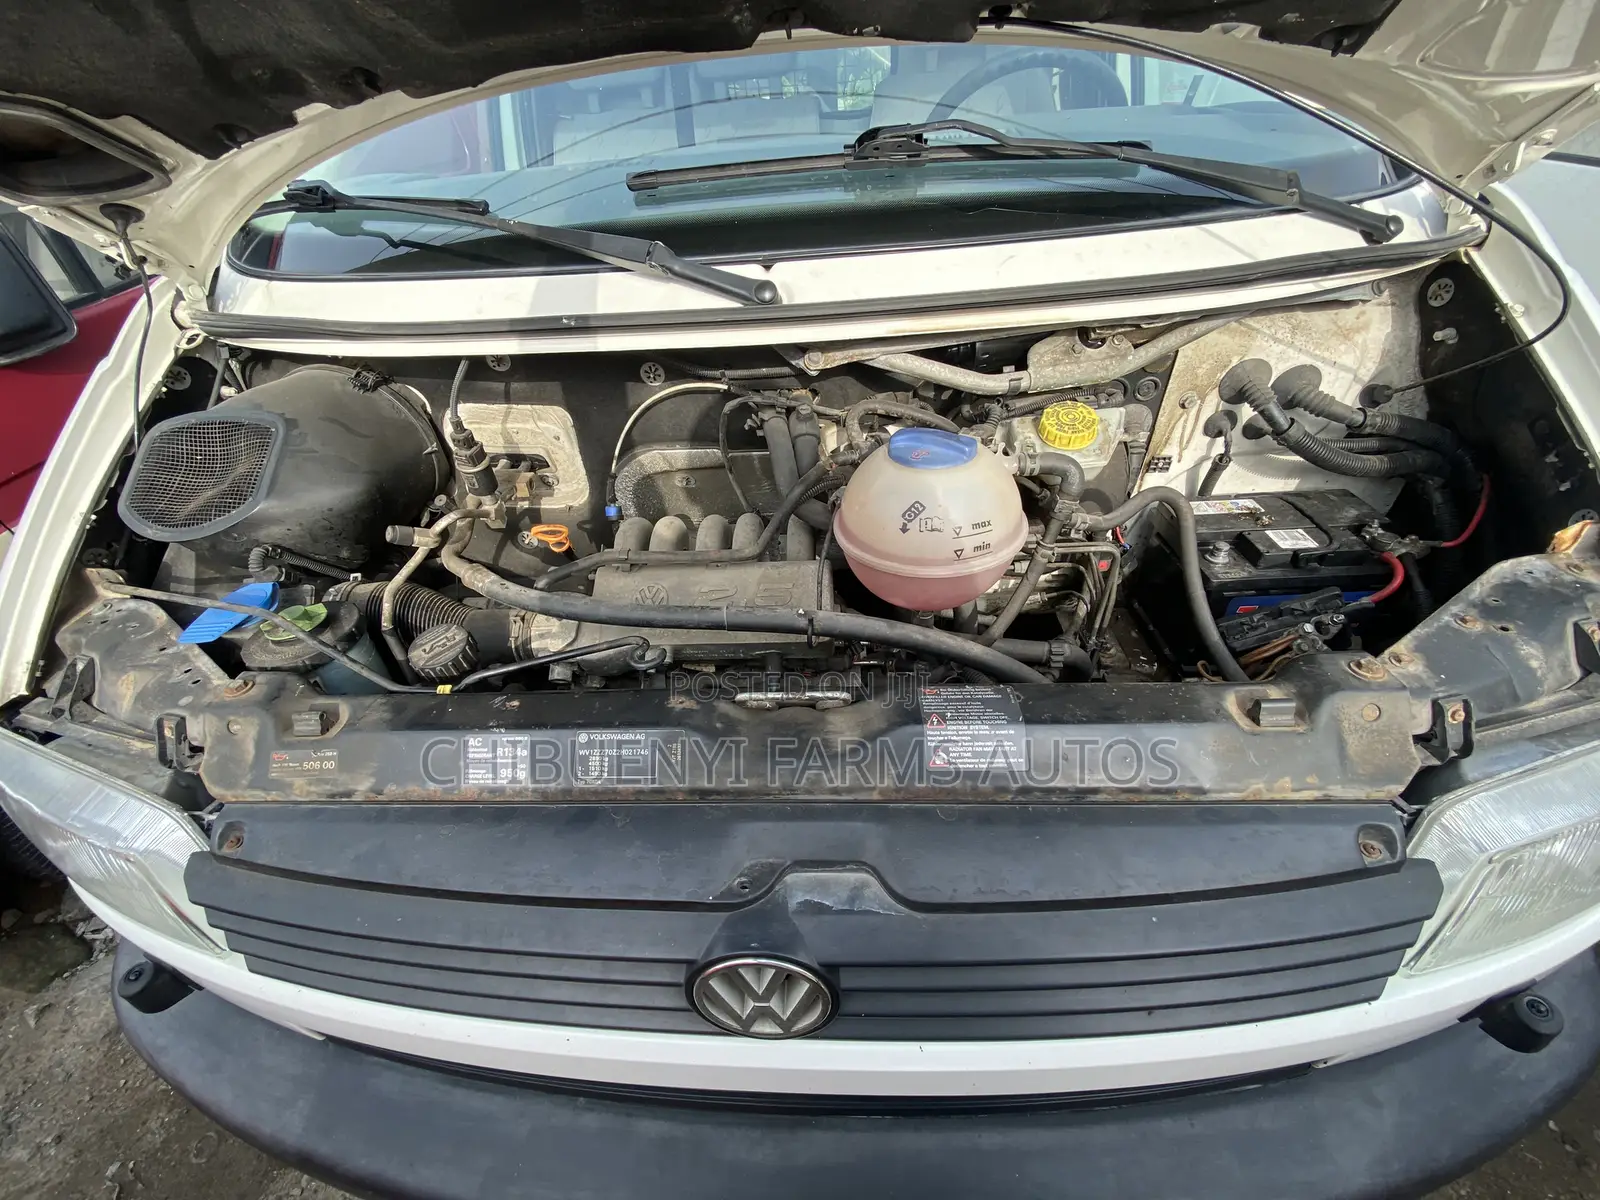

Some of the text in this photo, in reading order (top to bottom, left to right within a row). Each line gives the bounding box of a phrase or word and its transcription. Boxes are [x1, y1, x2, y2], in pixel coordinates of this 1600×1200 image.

[904, 502, 924, 520] G12
[971, 520, 992, 530] max
[973, 541, 990, 552] min
[468, 738, 482, 746] AC
[496, 748, 527, 756] R134a
[303, 761, 320, 770] 506
[322, 761, 335, 769] 00
